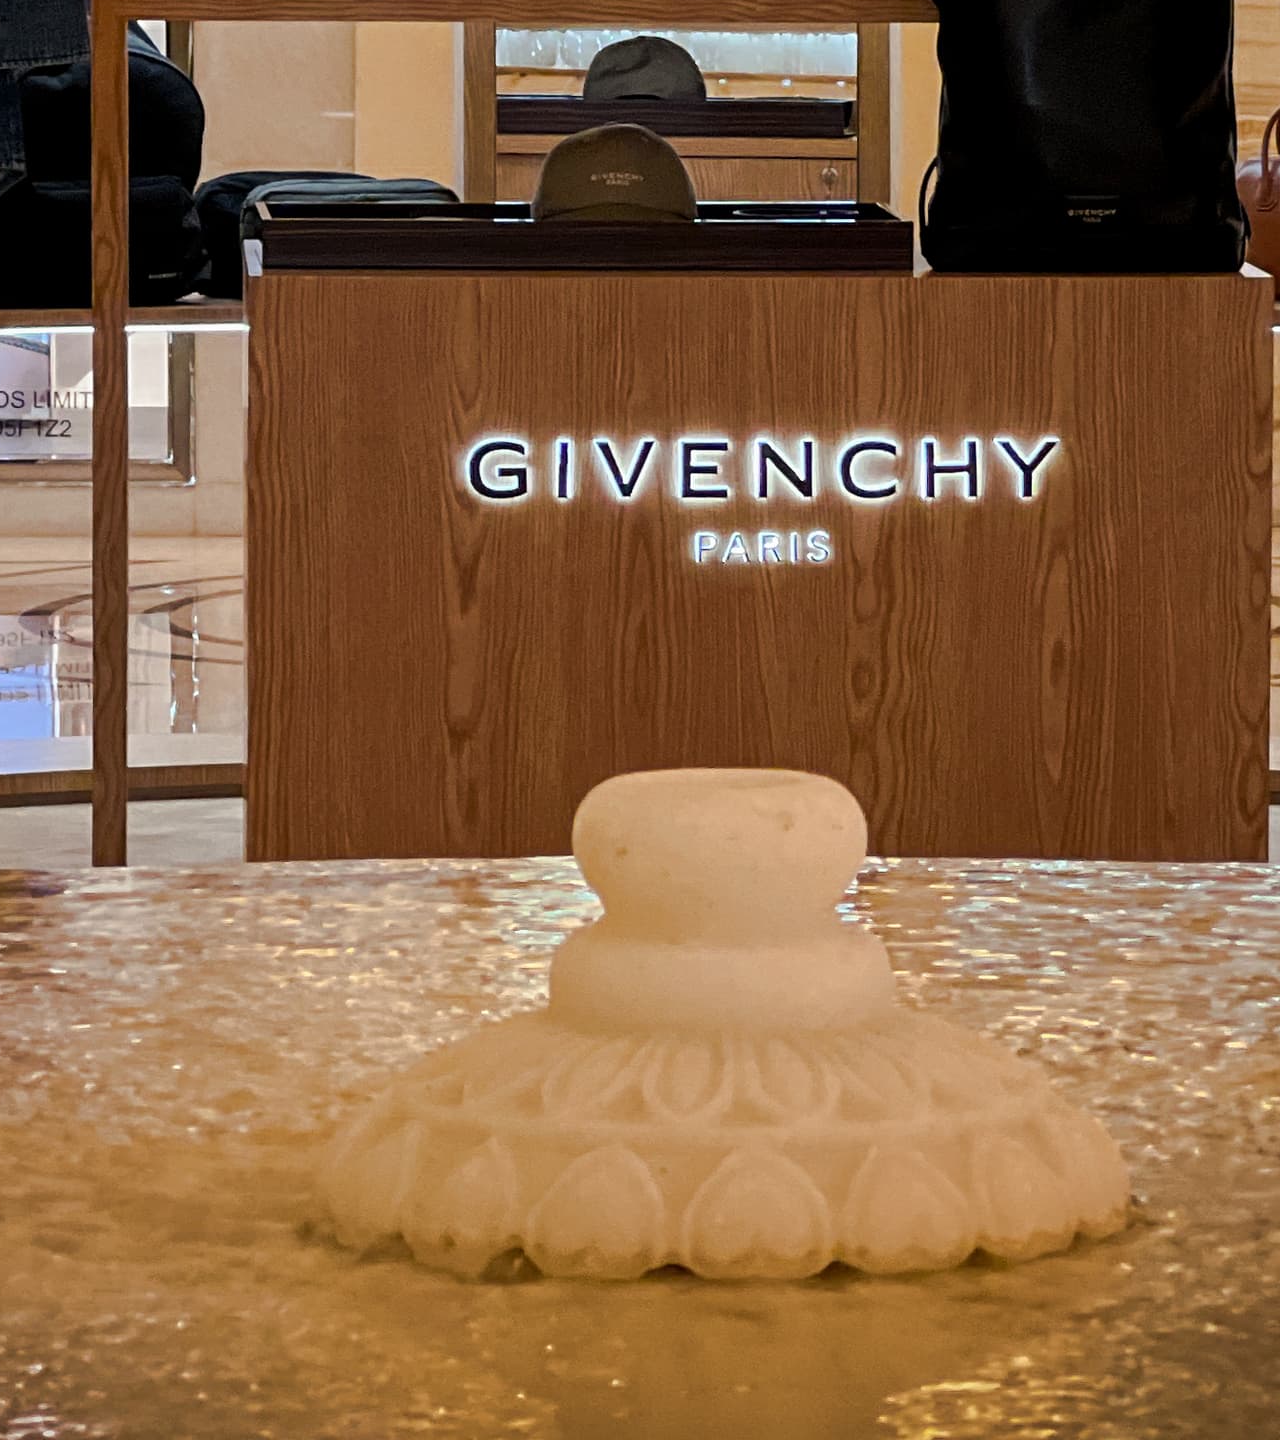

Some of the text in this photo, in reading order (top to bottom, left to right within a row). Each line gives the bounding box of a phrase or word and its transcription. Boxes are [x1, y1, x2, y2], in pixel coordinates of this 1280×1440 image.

[33, 391, 93, 408] LIMIT
[465, 436, 1062, 503] GIVENCHY
[693, 530, 832, 564] PARIS
